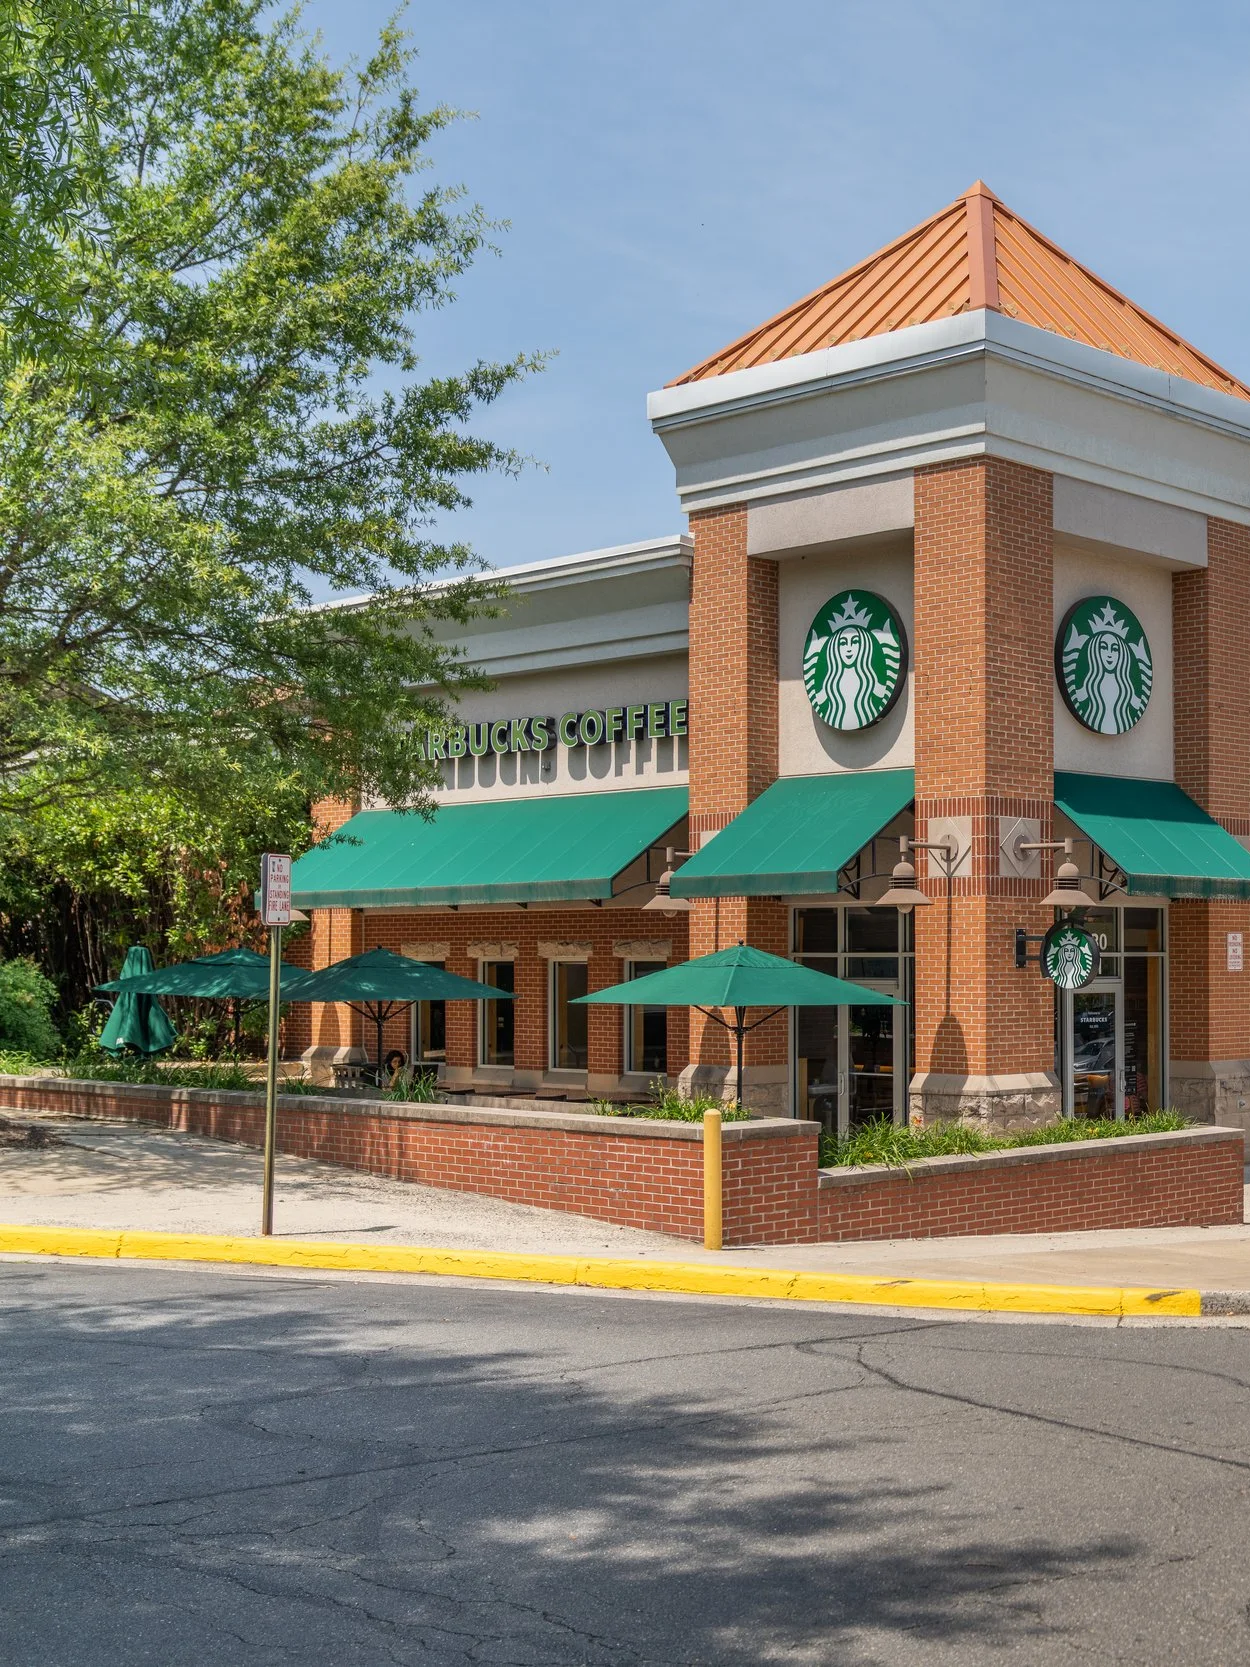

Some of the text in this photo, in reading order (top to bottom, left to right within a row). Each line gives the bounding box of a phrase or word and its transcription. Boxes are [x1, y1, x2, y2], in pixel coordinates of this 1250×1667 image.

[399, 699, 687, 760] ARBUCKS COFFEE
[276, 864, 283, 872] NO
[270, 874, 289, 883] PARKING
[269, 890, 290, 899] STANDING
[268, 901, 290, 911] FIRE LANE
